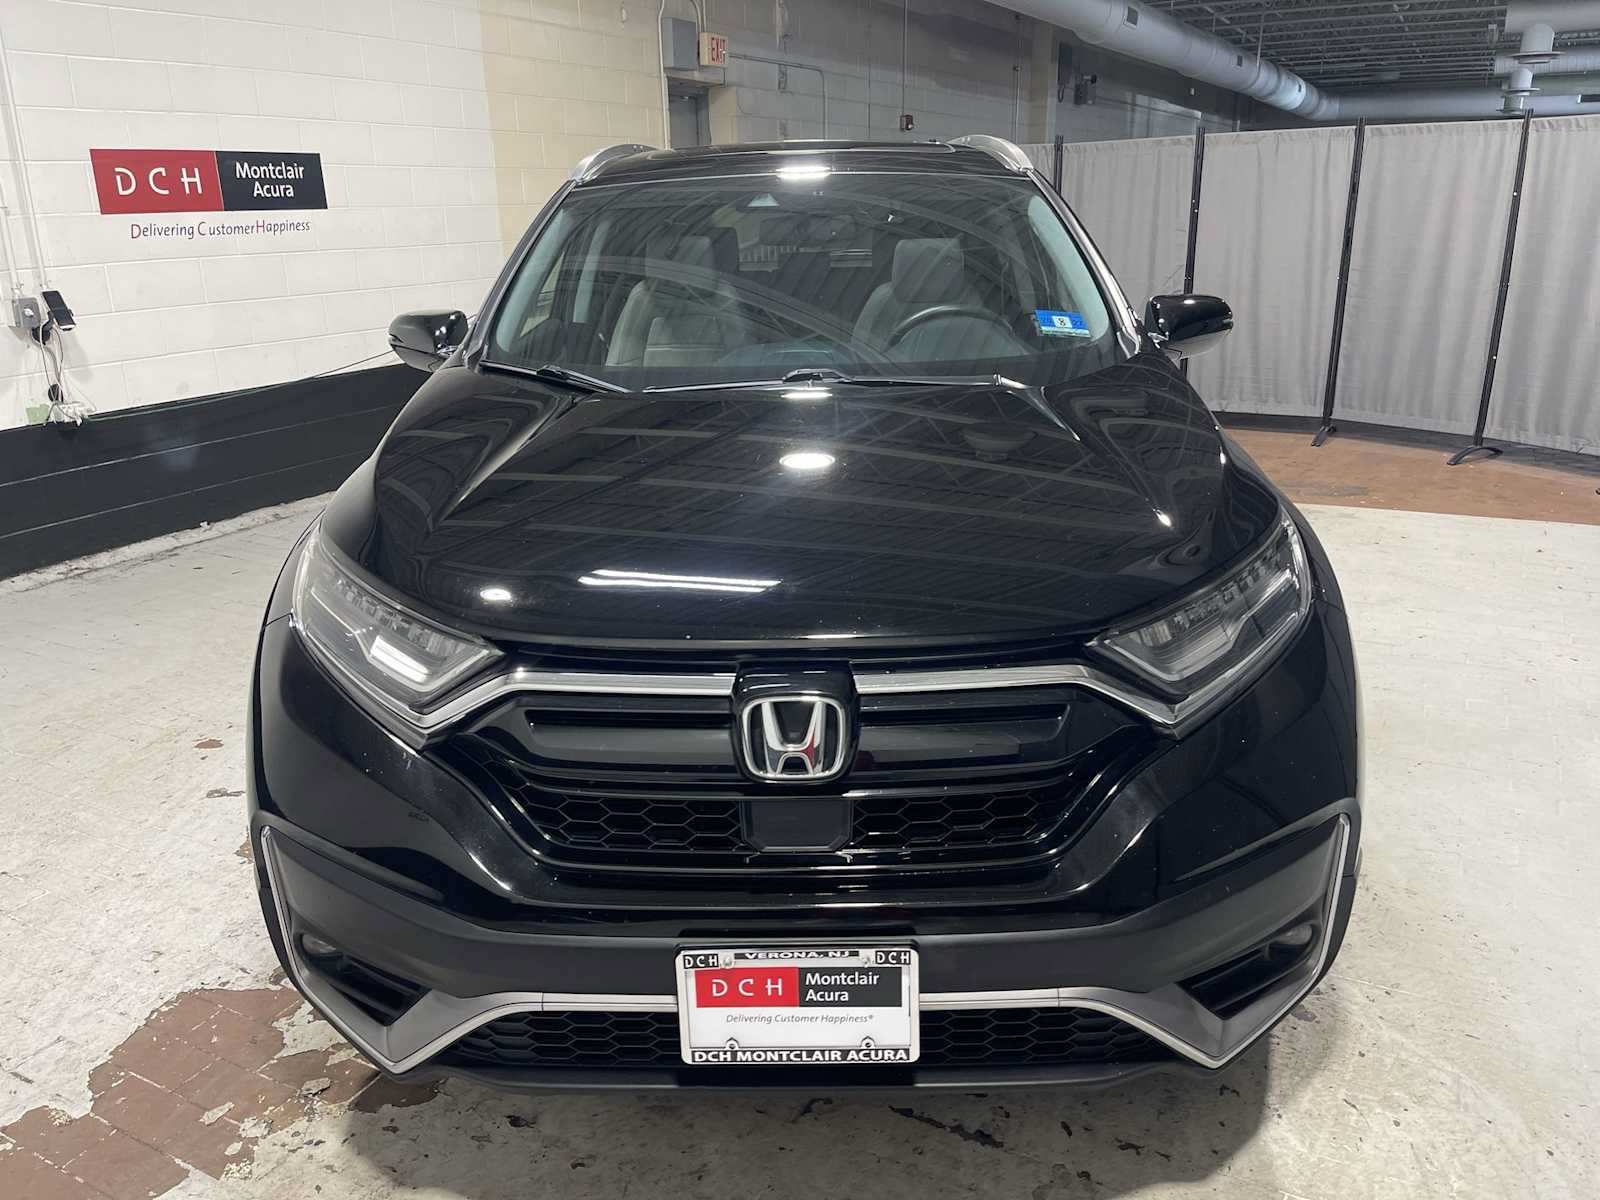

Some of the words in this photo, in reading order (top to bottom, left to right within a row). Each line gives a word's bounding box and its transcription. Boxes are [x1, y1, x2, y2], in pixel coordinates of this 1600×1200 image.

[711, 37, 726, 64] EXIT
[235, 161, 304, 179] Montclair
[253, 181, 294, 198] Acura
[130, 223, 194, 239] Delivering
[684, 956, 719, 968] DCH
[745, 952, 824, 960] VERONA,
[828, 950, 850, 958] NJ
[876, 951, 910, 965] DCH
[805, 972, 880, 986] Montclair
[805, 988, 849, 1002] Acura
[726, 1014, 772, 1025] Delivering
[774, 1014, 819, 1024] Customer
[693, 1050, 732, 1063] DCH
[736, 1049, 842, 1062] MONTCLAIR
[846, 1049, 908, 1062] ACURA
